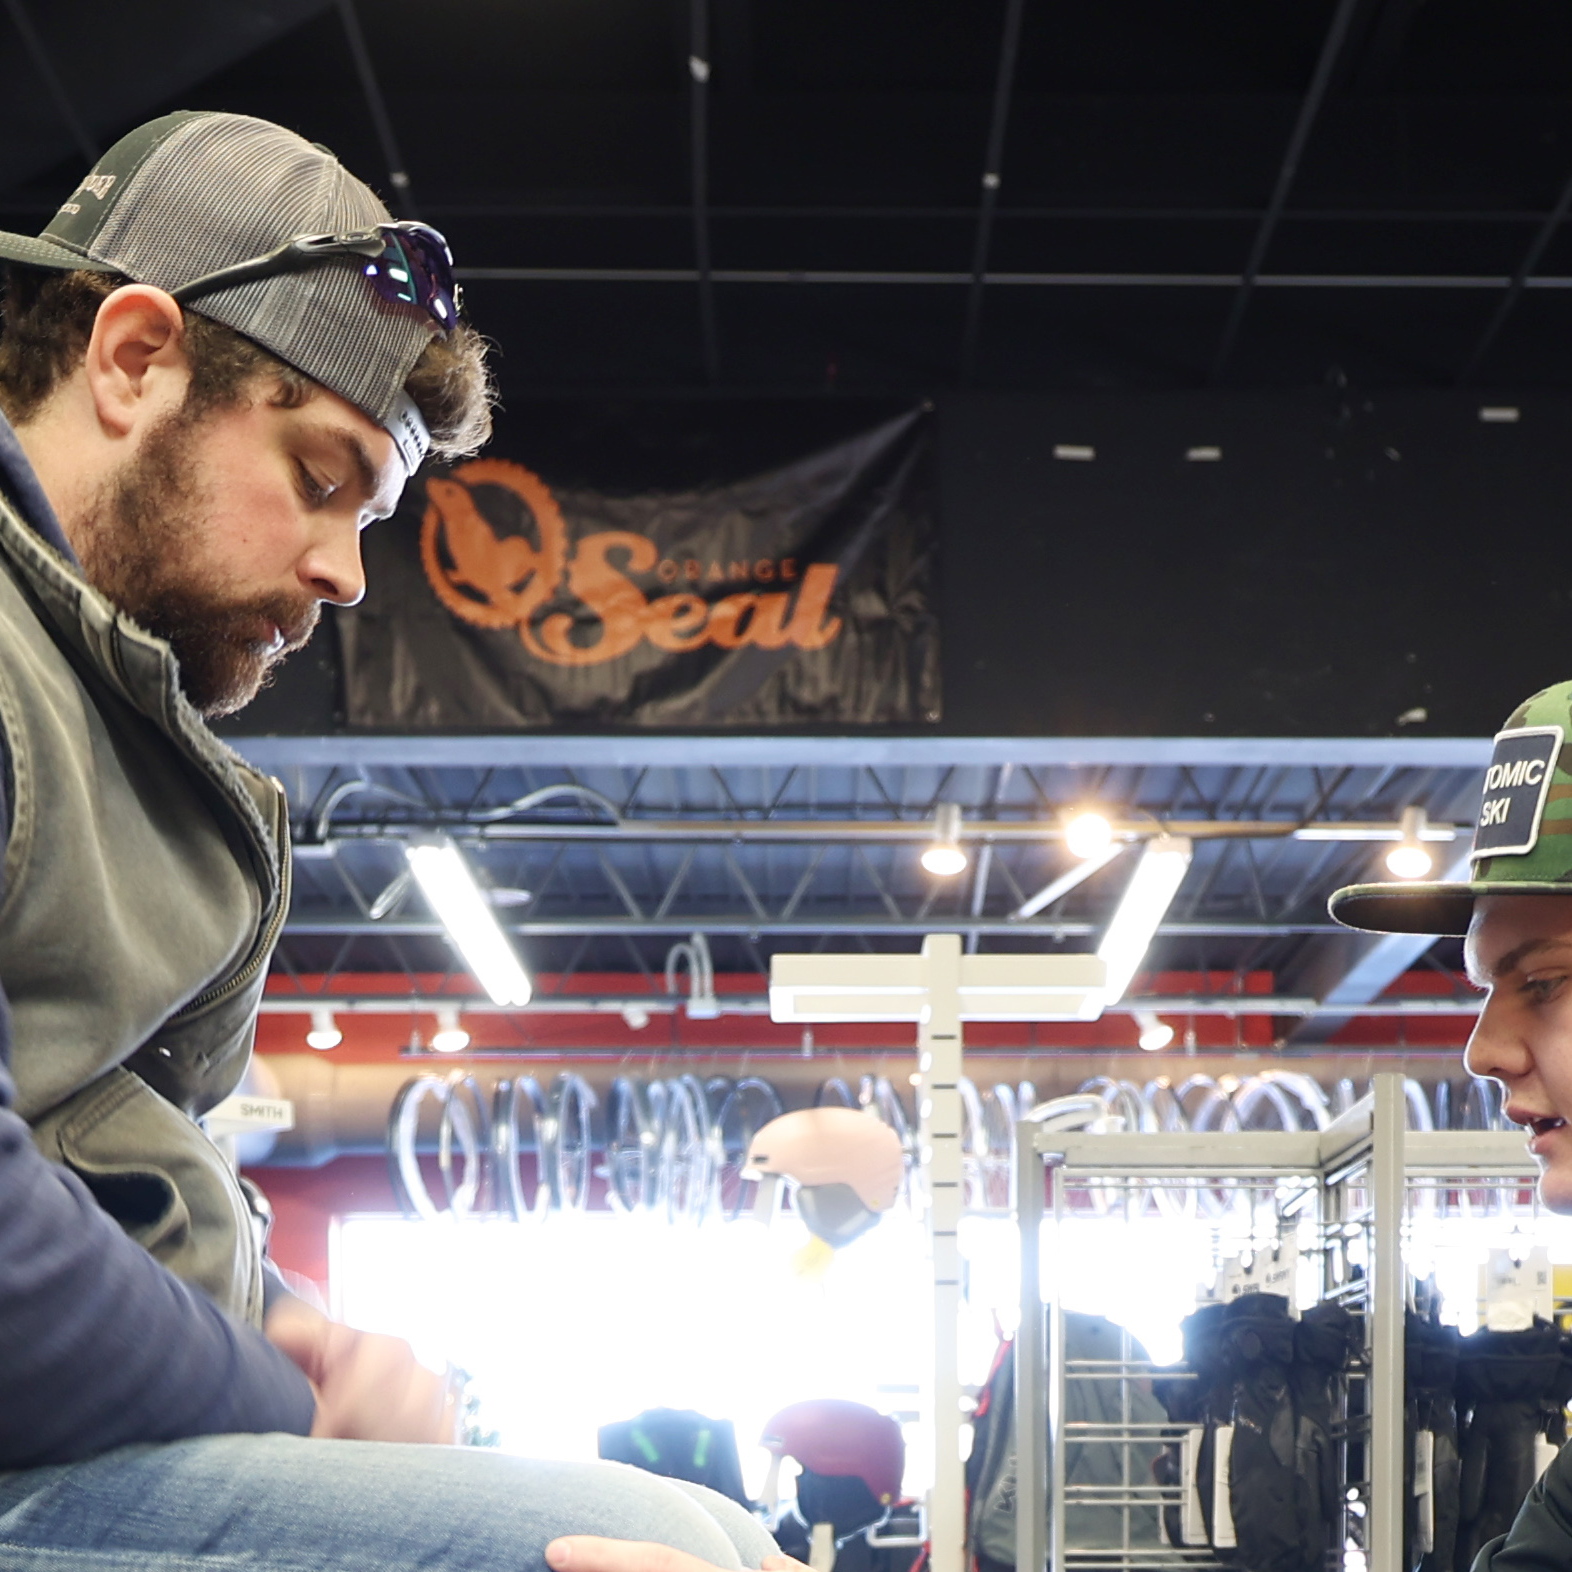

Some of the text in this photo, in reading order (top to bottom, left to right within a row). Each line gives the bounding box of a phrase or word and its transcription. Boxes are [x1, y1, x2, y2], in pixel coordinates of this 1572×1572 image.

[657, 557, 797, 583] ORANGE
[519, 531, 843, 667] Seal
[1480, 797, 1511, 827] SKI
